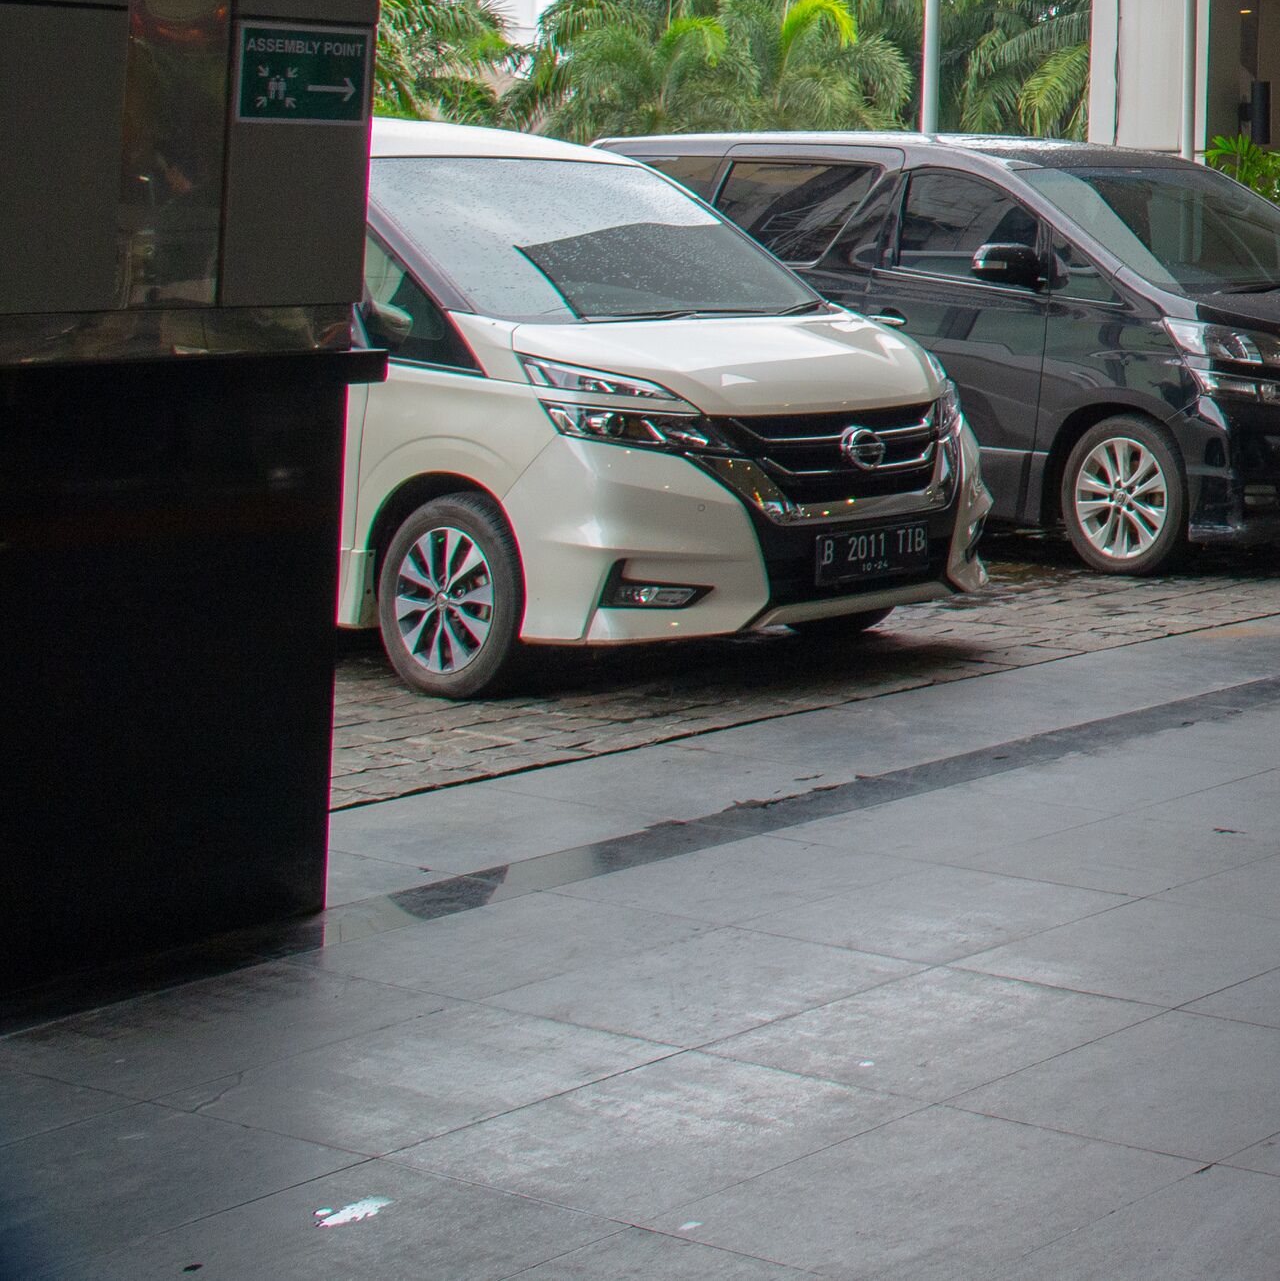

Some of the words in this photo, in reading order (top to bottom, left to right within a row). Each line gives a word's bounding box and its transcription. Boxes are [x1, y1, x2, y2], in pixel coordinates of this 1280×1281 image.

[246, 38, 320, 55] ASSEMBLY
[323, 41, 363, 57] POINT
[822, 539, 834, 566] B
[847, 532, 886, 561] 2011
[897, 528, 926, 554] TIB
